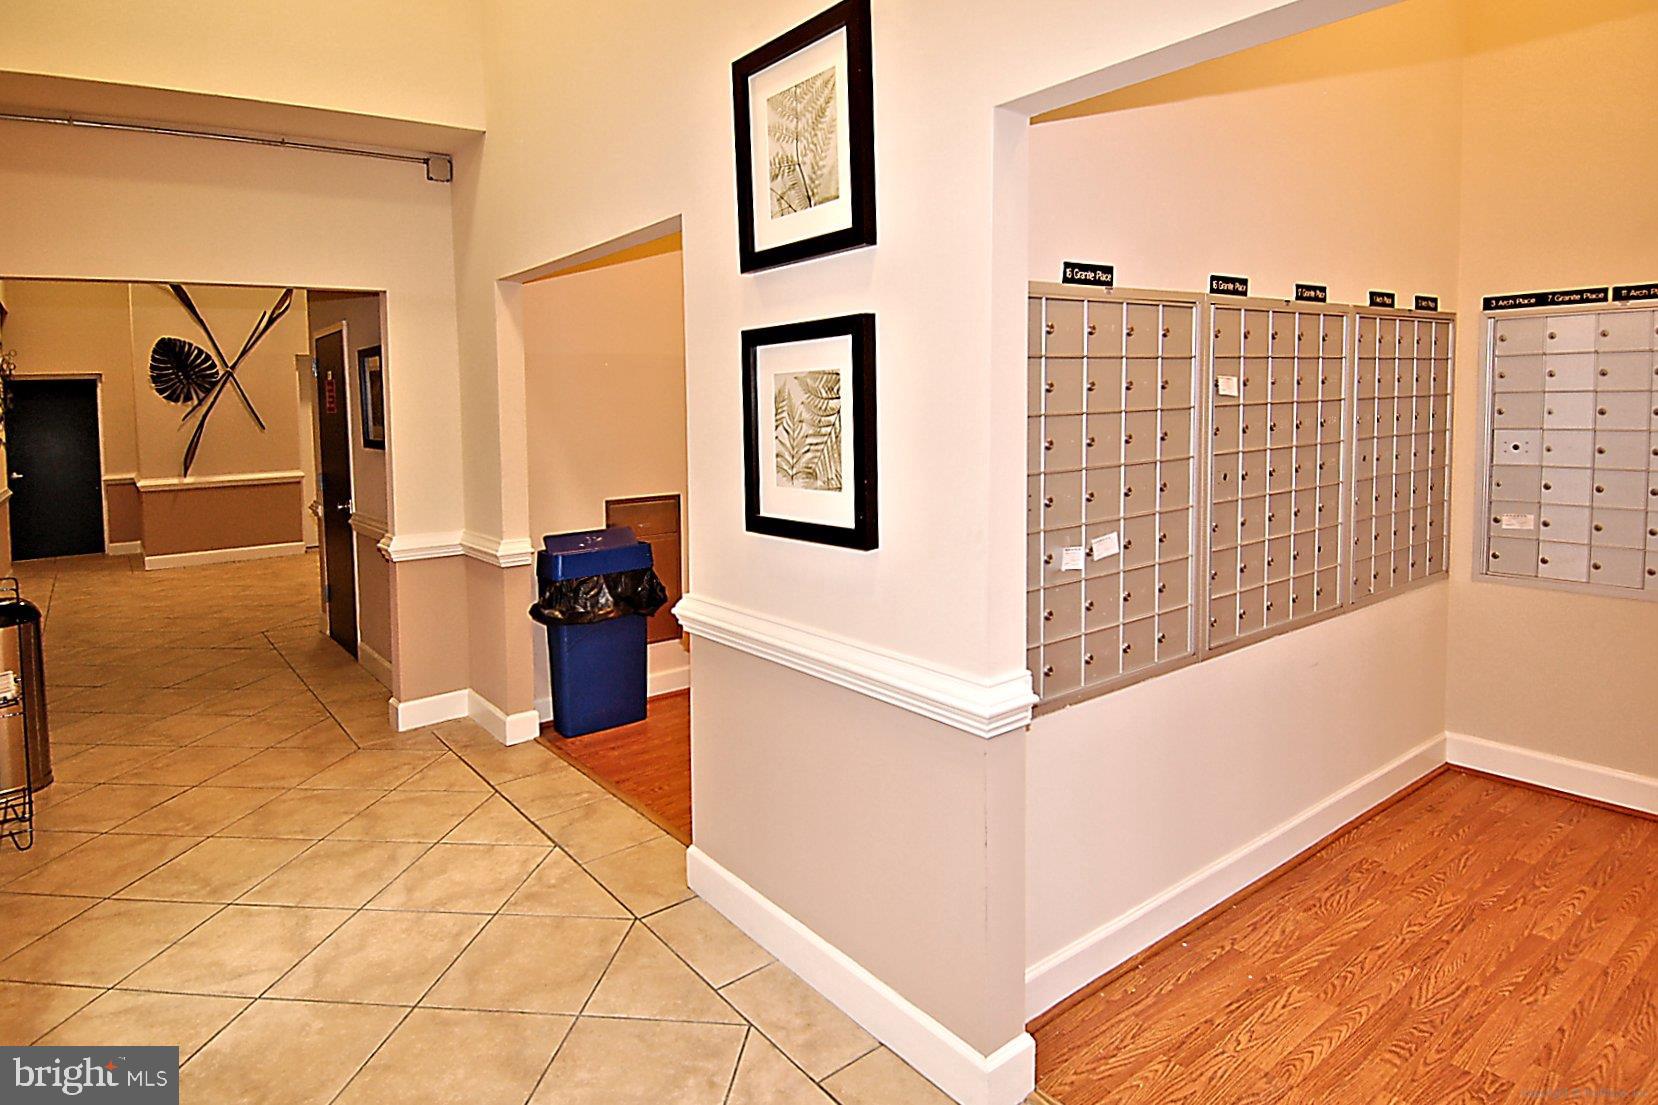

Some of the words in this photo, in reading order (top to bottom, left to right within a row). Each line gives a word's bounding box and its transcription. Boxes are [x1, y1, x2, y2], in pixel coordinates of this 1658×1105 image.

[1096, 270, 1112, 282] Place
[1547, 294, 1553, 303] 7
[1583, 291, 1605, 300] Place
[1629, 288, 1649, 297] Arch
[1490, 300, 1496, 308] 3
[1498, 299, 1514, 307] Arch
[1516, 297, 1536, 305] Place
